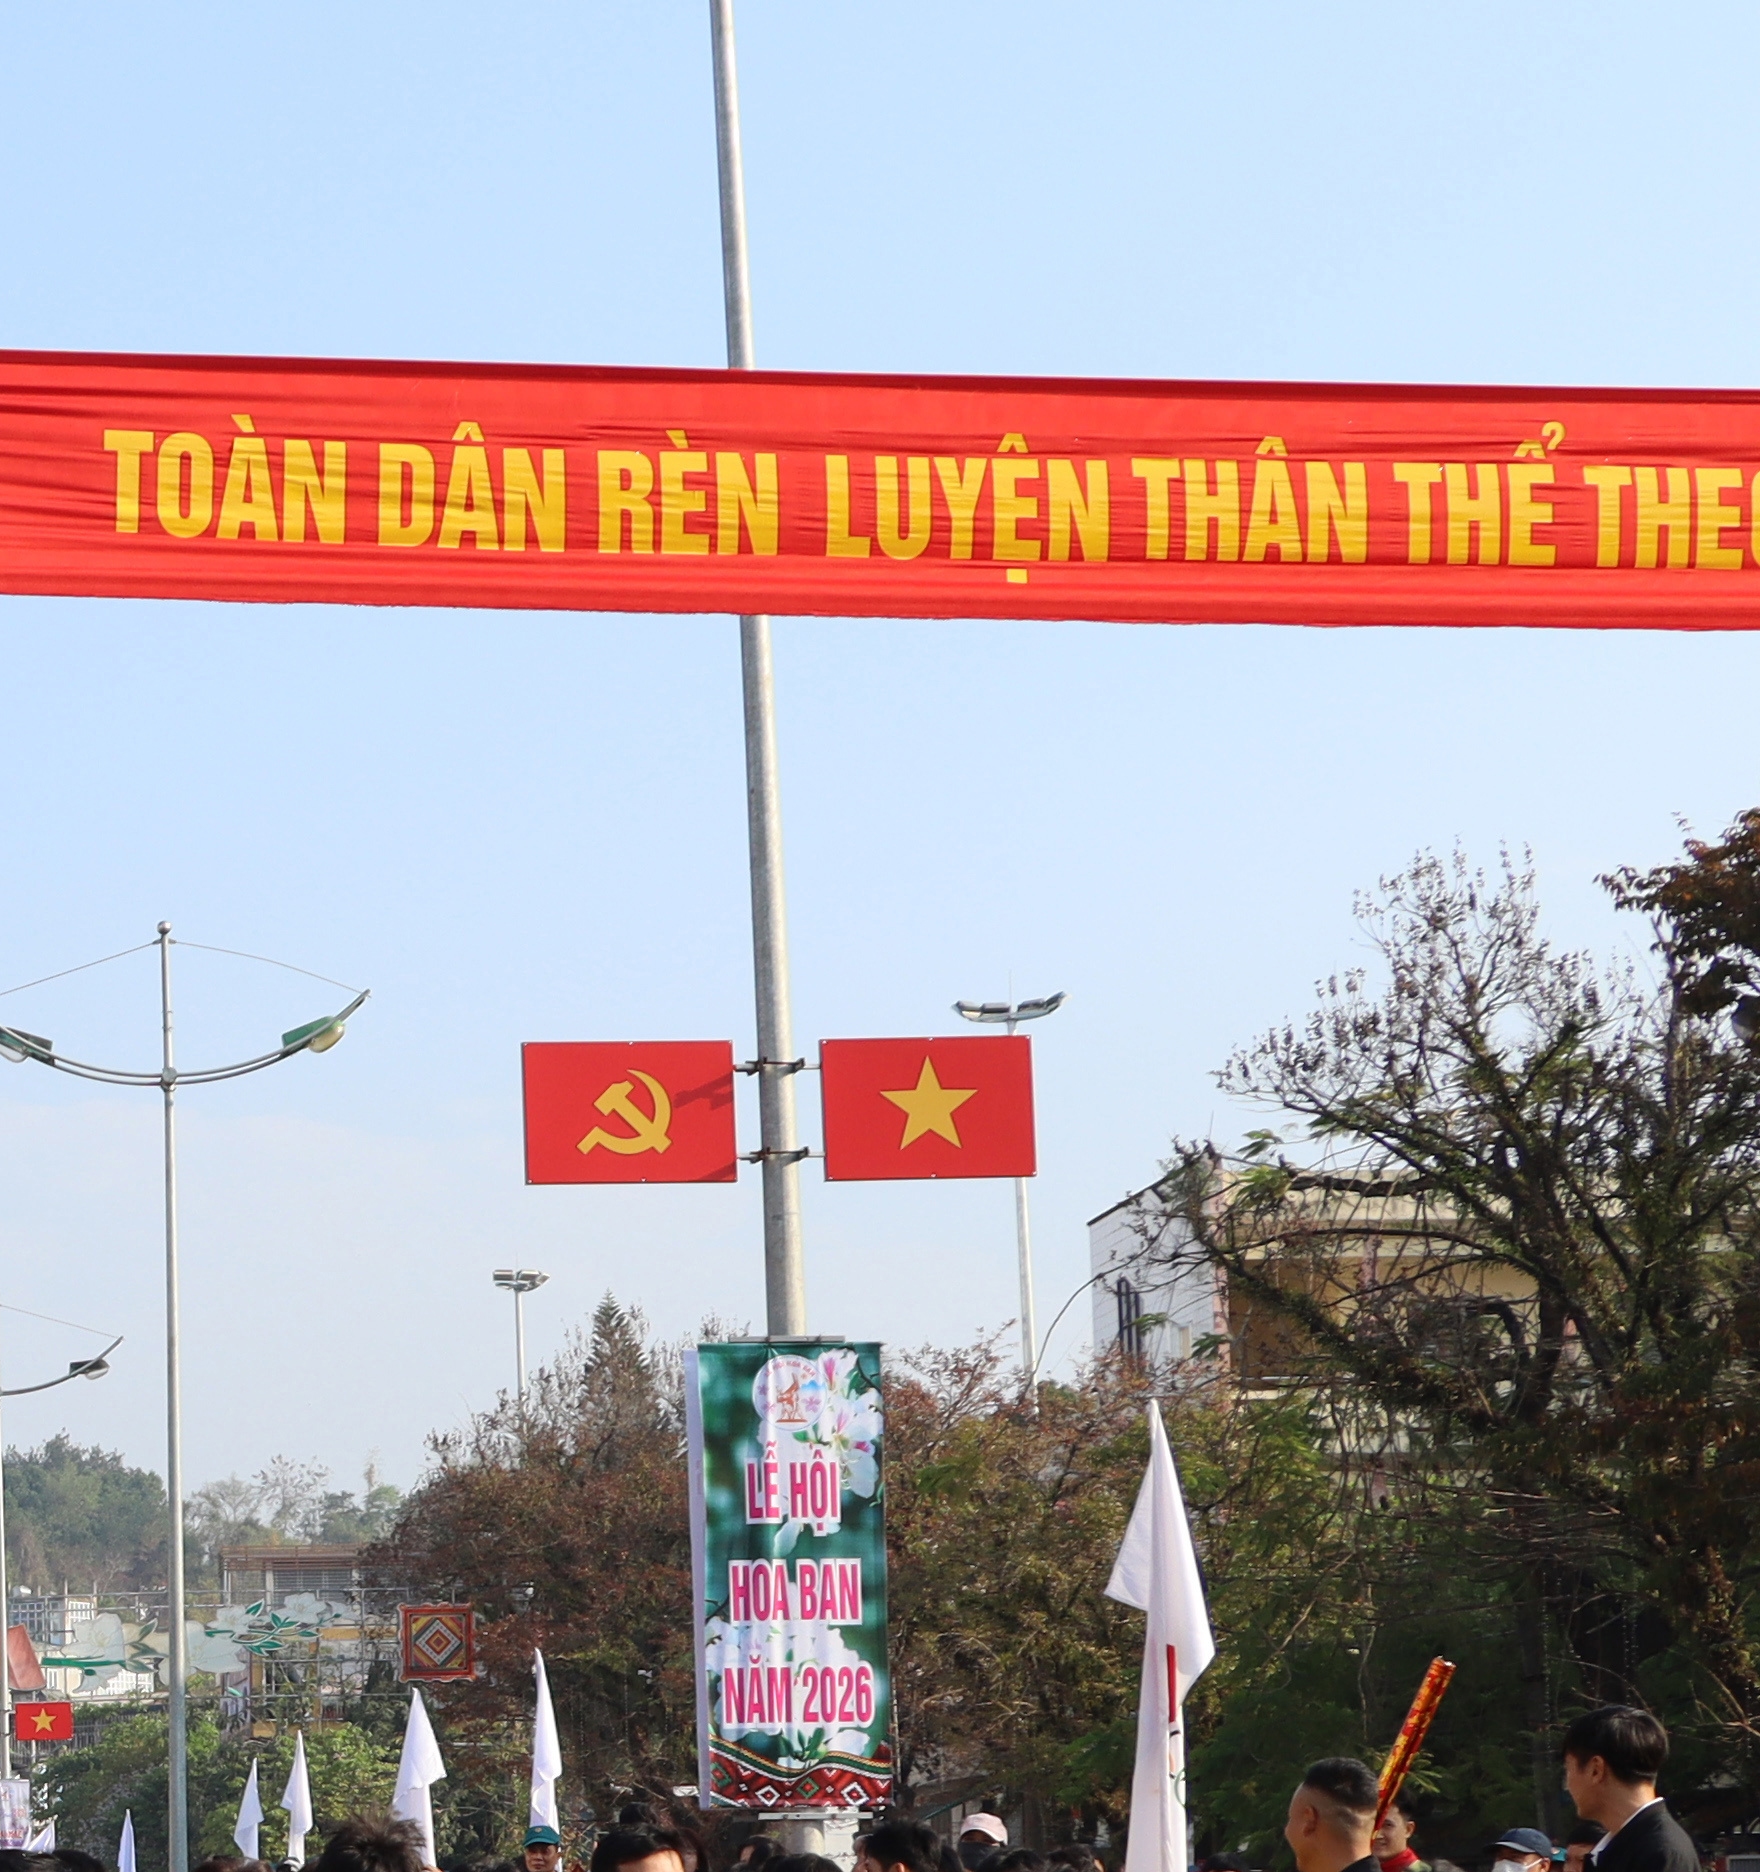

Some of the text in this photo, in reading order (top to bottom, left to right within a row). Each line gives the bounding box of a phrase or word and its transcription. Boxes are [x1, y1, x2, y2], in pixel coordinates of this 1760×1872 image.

[103, 413, 1760, 585] TOÀN DÂN RÈN LUYỆN THÂN THỂ THE
[747, 1440, 840, 1532] LỄ HỘI
[731, 1563, 860, 1622] HOA BAN
[723, 1654, 875, 1724] NĂM 2026
